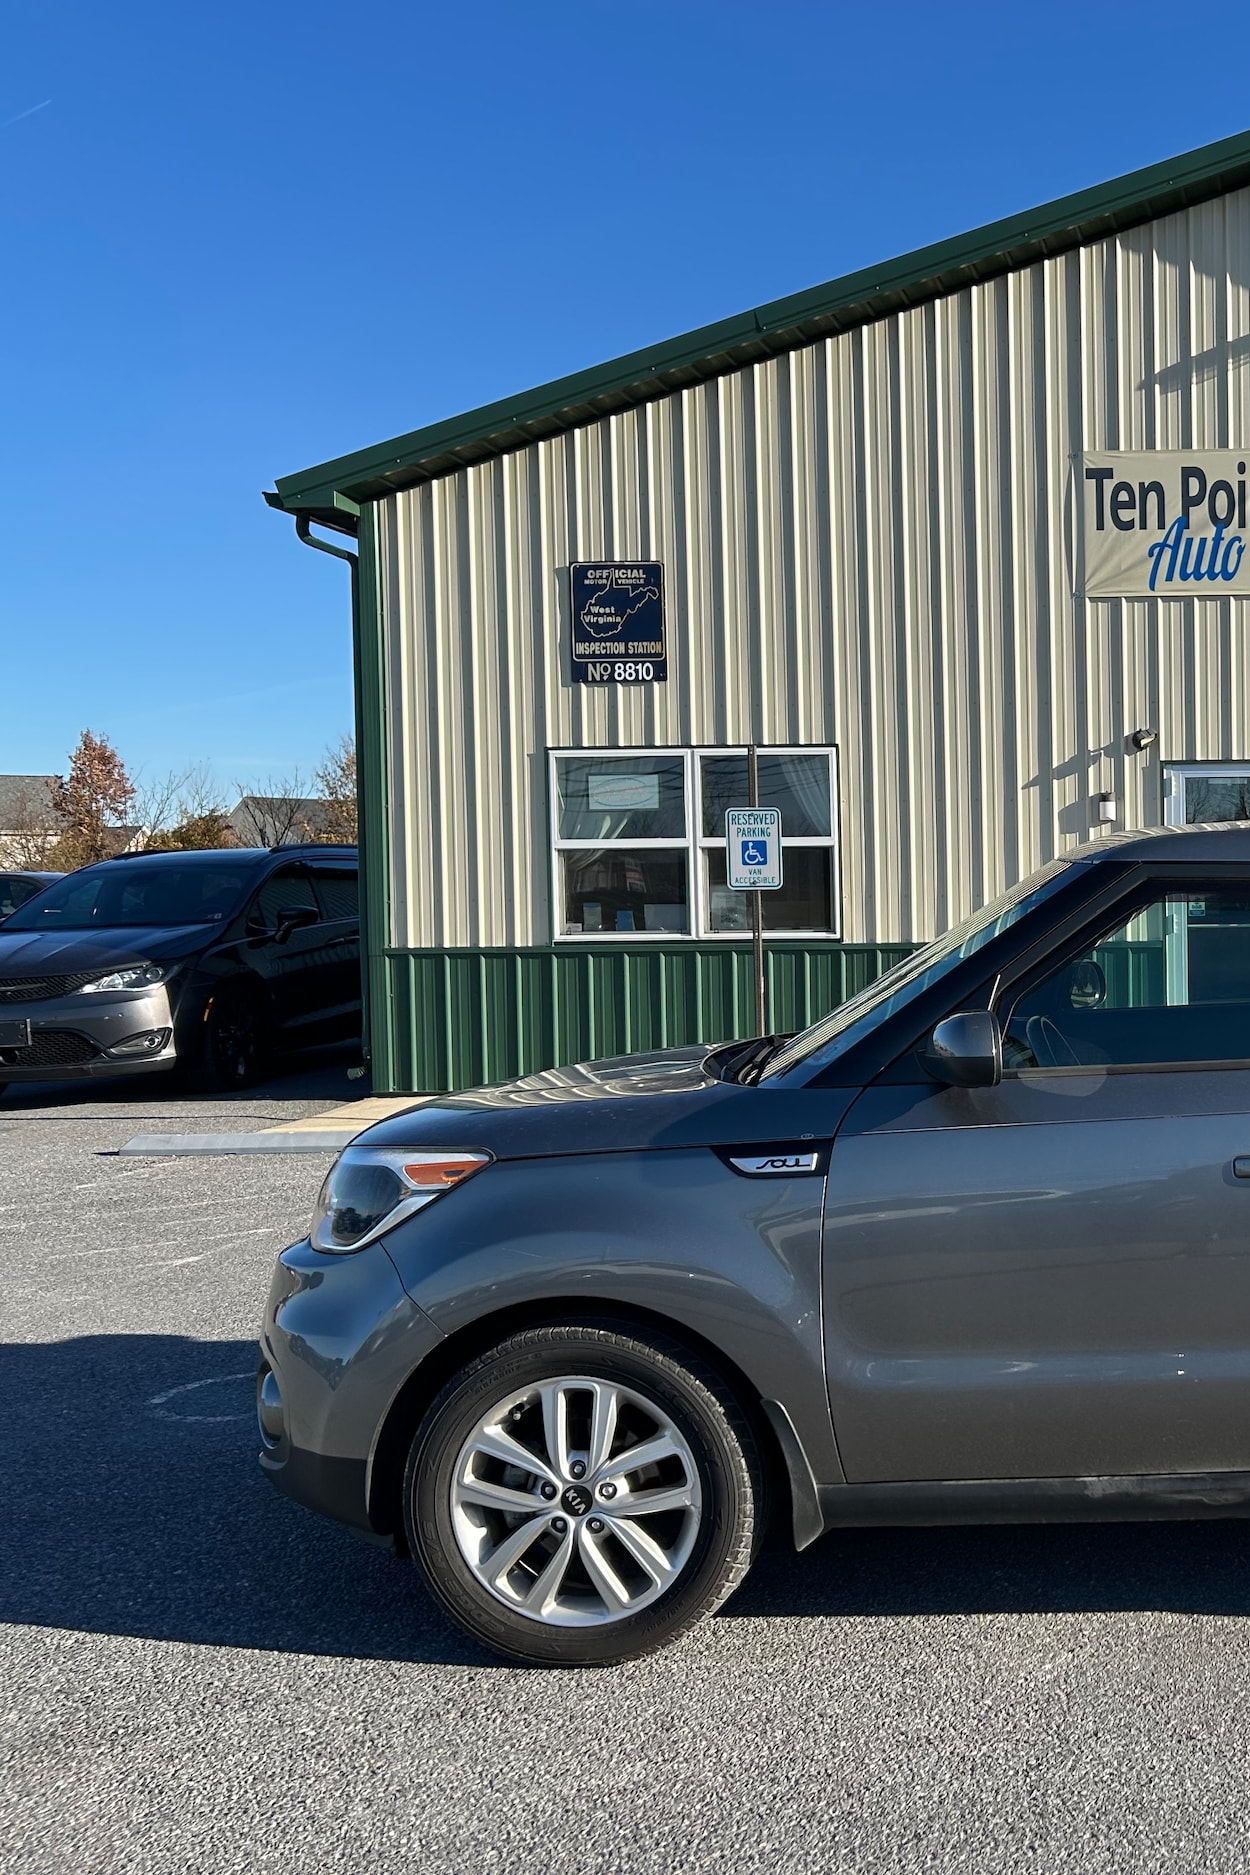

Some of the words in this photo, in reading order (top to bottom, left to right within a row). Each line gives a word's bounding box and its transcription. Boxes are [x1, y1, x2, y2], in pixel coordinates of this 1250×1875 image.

[1085, 467, 1166, 531] Ten
[1147, 516, 1247, 591] Auto
[587, 569, 646, 578] OFFICIAL
[590, 606, 615, 614] West
[583, 615, 621, 624] Virginia
[576, 642, 625, 655] INSPECTION
[628, 641, 663, 654] STATION
[614, 662, 654, 681] 8810
[731, 813, 776, 825] RESERVED
[737, 827, 771, 838] PARKING
[565, 1489, 586, 1514] KIA
